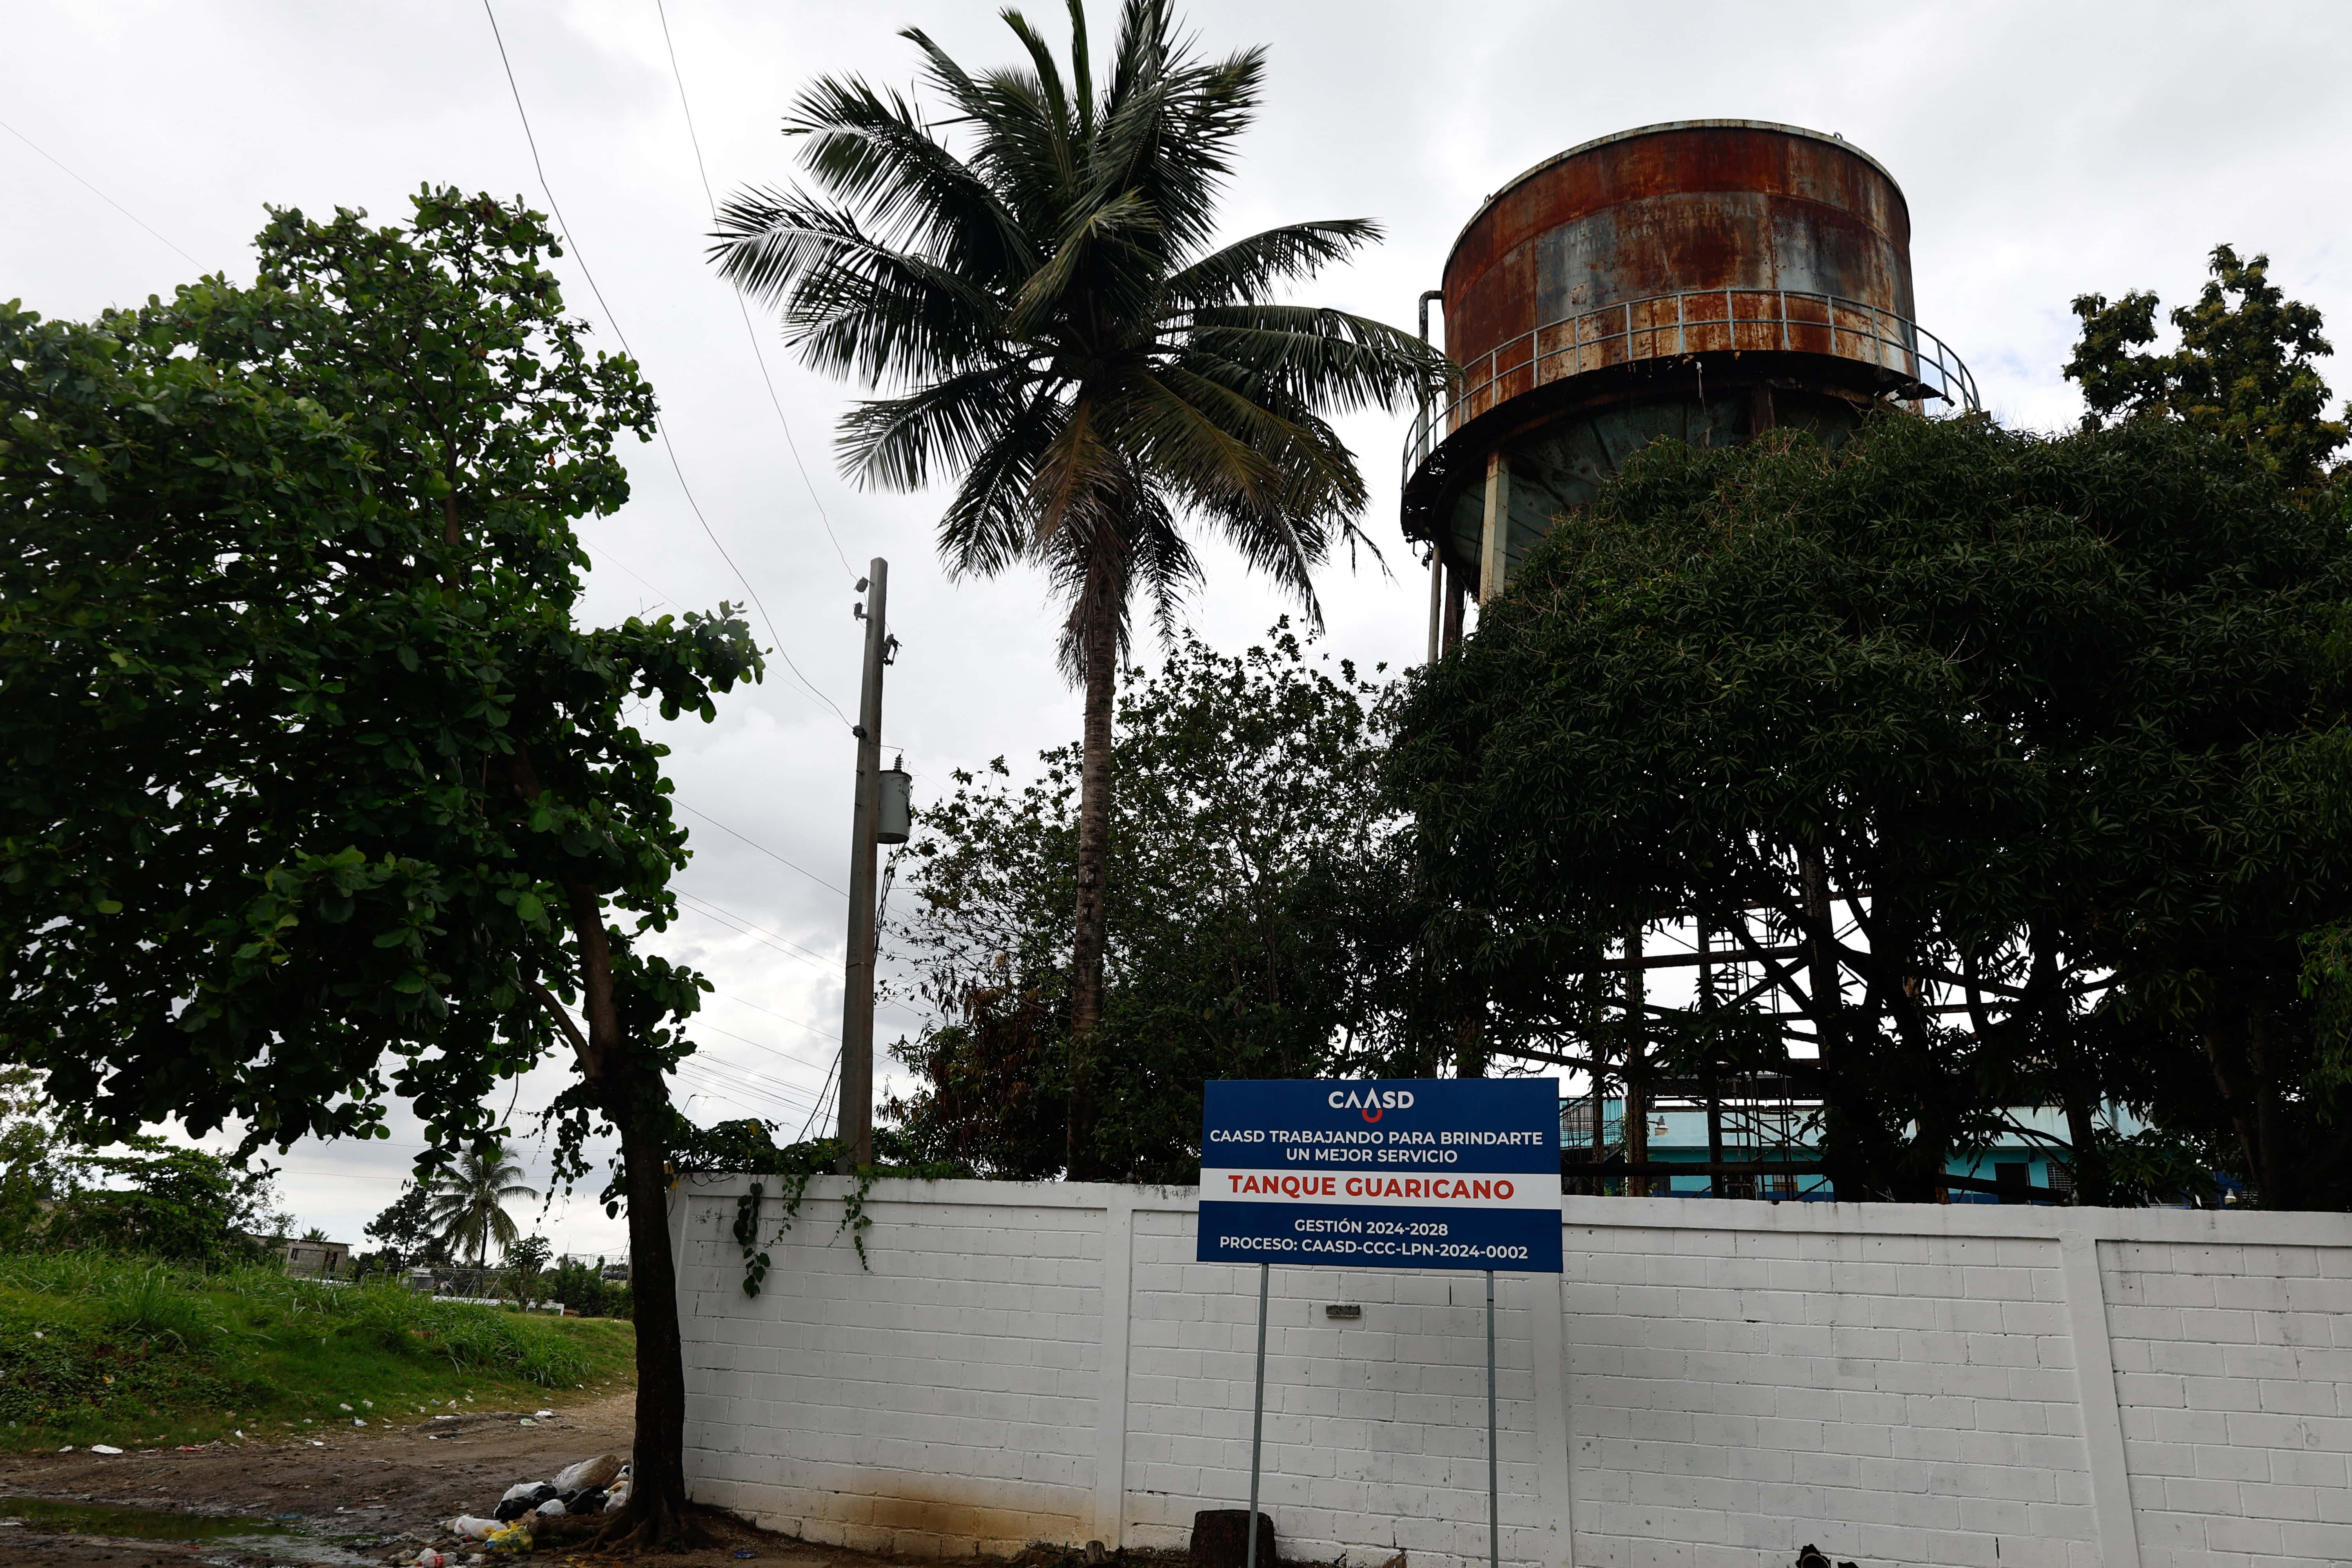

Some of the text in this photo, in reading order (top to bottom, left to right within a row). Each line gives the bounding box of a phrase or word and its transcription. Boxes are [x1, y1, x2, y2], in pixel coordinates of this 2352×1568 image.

[1576, 224, 1653, 256] MIROR
[1328, 1087, 1414, 1109] CAASD
[1210, 1130, 1543, 1145] CAASD TRABAJANDO PARA BRINDARTE
[1287, 1148, 1457, 1163] UN MEJOR SERVICIO
[1228, 1175, 1514, 1200] TANQUE GUARICANO
[1295, 1218, 1448, 1236] GESTIÓN 2024-2028
[1220, 1236, 1528, 1259] PROCESO: CAASD-CCC-LPN-2024-0002
